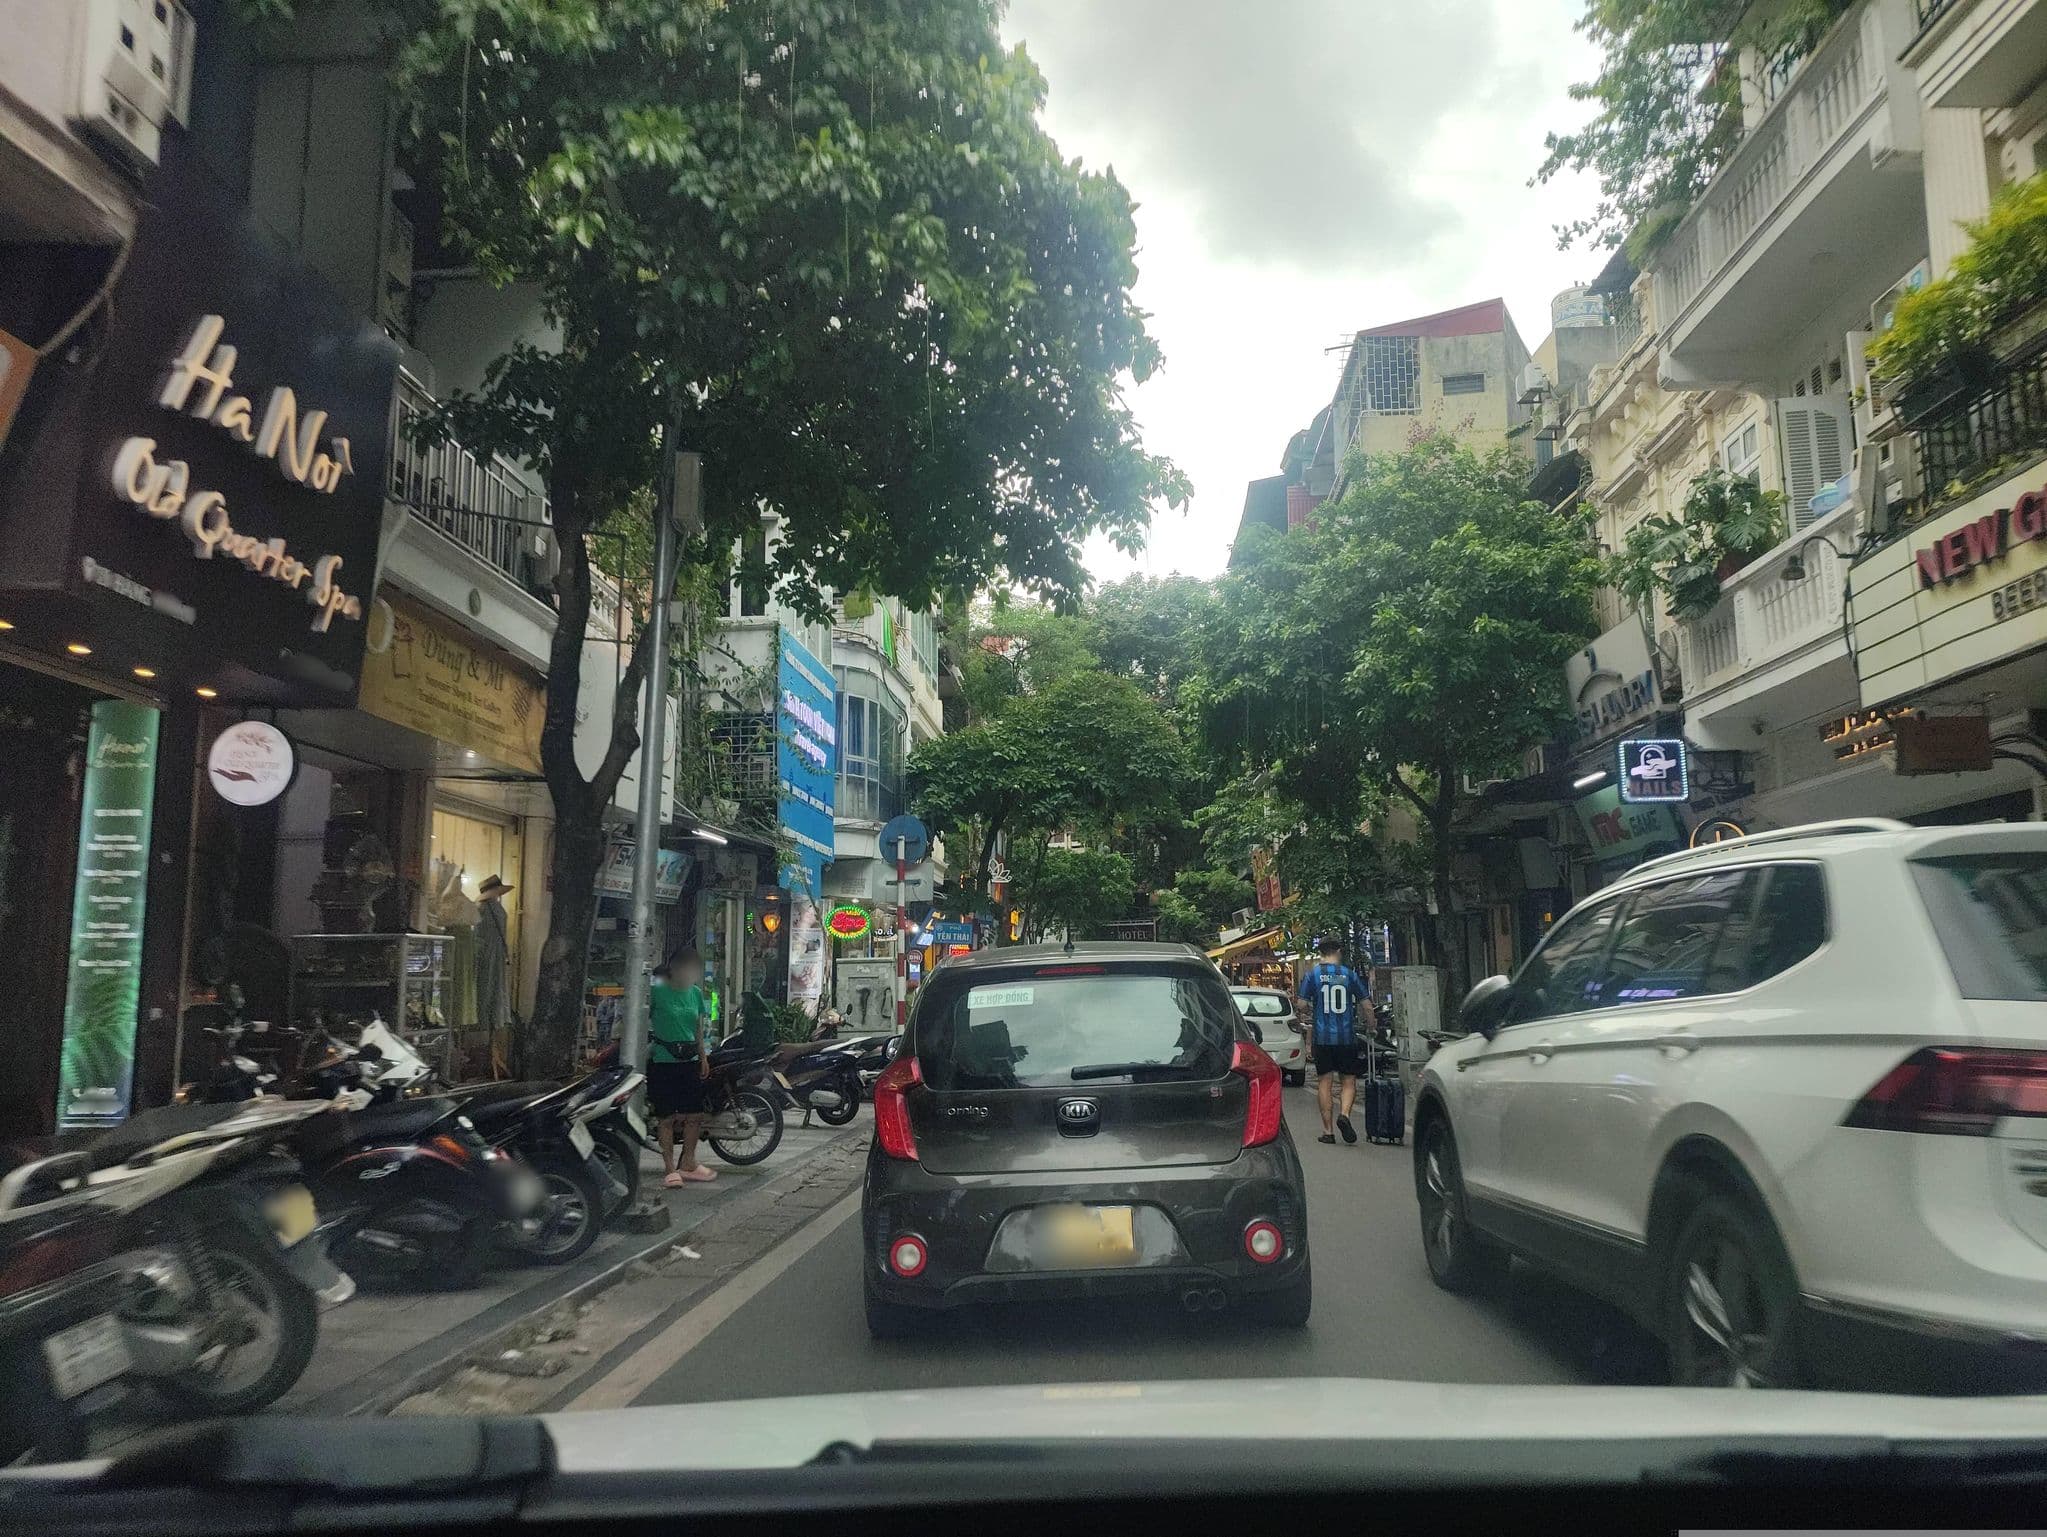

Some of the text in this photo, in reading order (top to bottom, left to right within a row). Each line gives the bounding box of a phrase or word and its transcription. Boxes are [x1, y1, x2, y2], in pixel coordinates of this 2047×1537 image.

[112, 437, 190, 519] Old
[180, 491, 312, 588] Quarter
[308, 555, 362, 632] Spa
[1916, 483, 2047, 590] NEW G
[1628, 781, 1682, 796] NAILS
[974, 995, 985, 1005] XE
[1320, 984, 1347, 1014] 10
[1065, 1105, 1091, 1117] KIA
